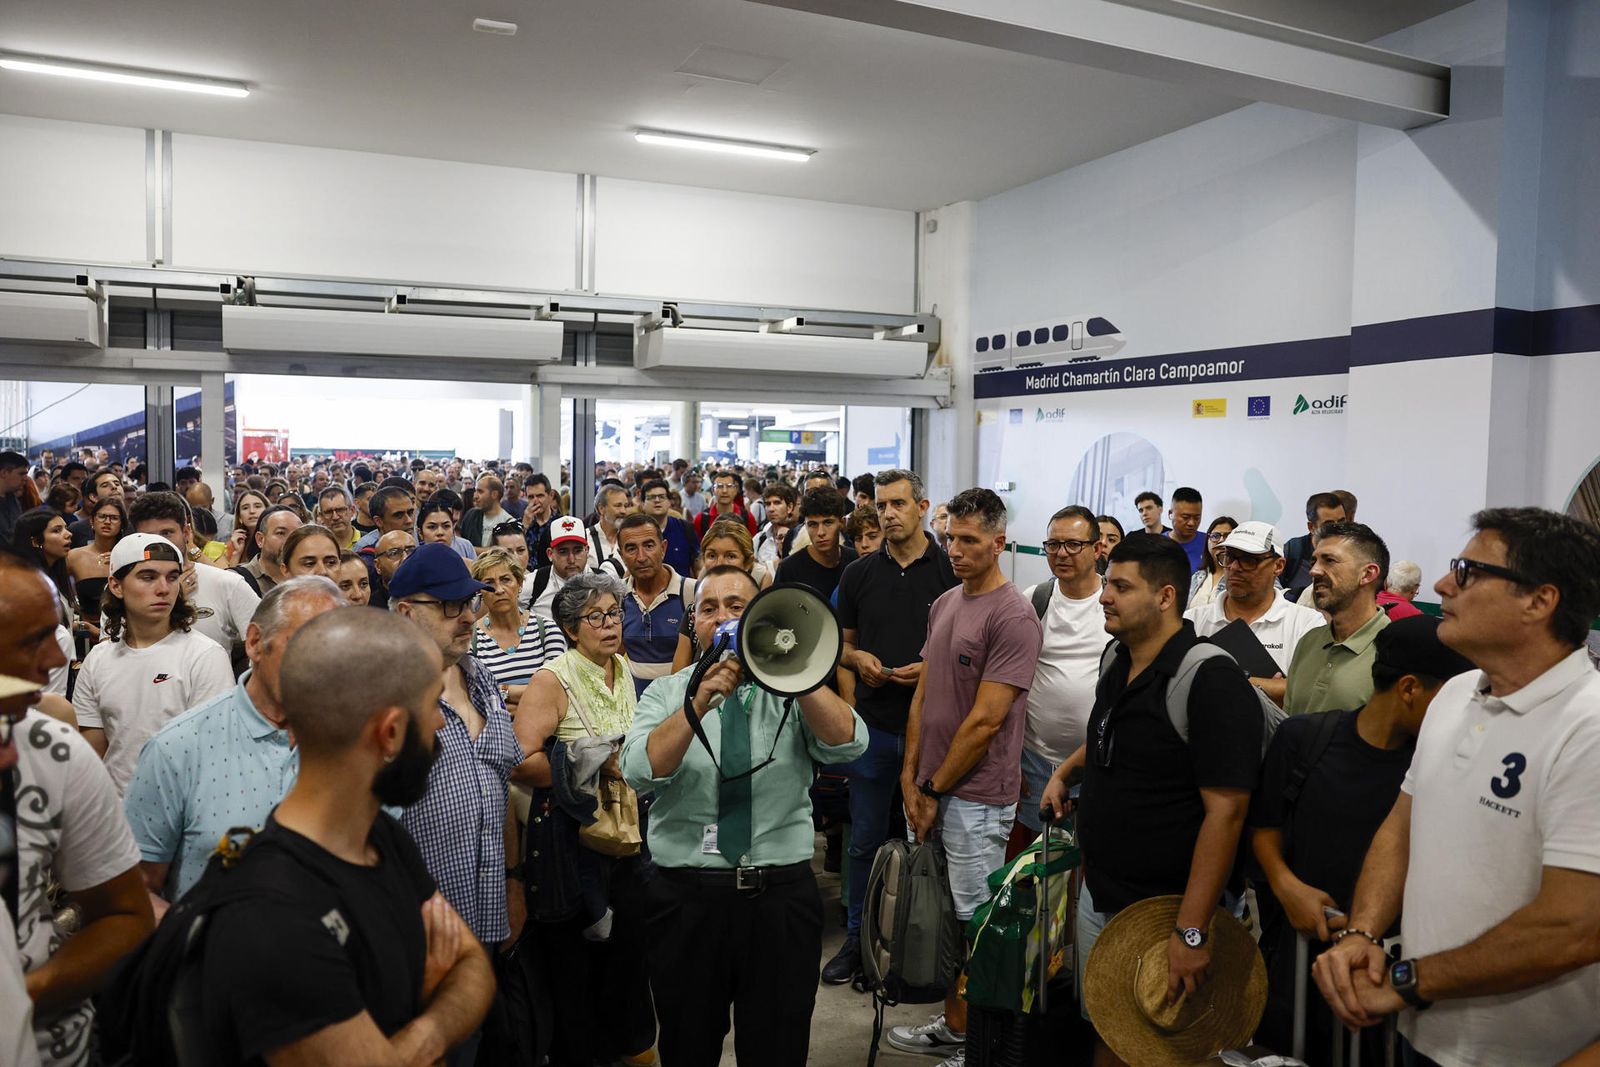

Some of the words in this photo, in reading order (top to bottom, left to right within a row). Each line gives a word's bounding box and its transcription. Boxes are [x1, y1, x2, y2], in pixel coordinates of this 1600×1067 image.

[1025, 372, 1060, 390] Madrid
[1062, 368, 1120, 387] Chamartín
[1123, 365, 1156, 382] Clara
[1159, 360, 1245, 381] Campoamor
[1311, 394, 1348, 409] adif
[1045, 407, 1066, 419] adif
[792, 432, 799, 441] P
[1490, 751, 1527, 799] 3
[1479, 795, 1521, 819] HACKETT
